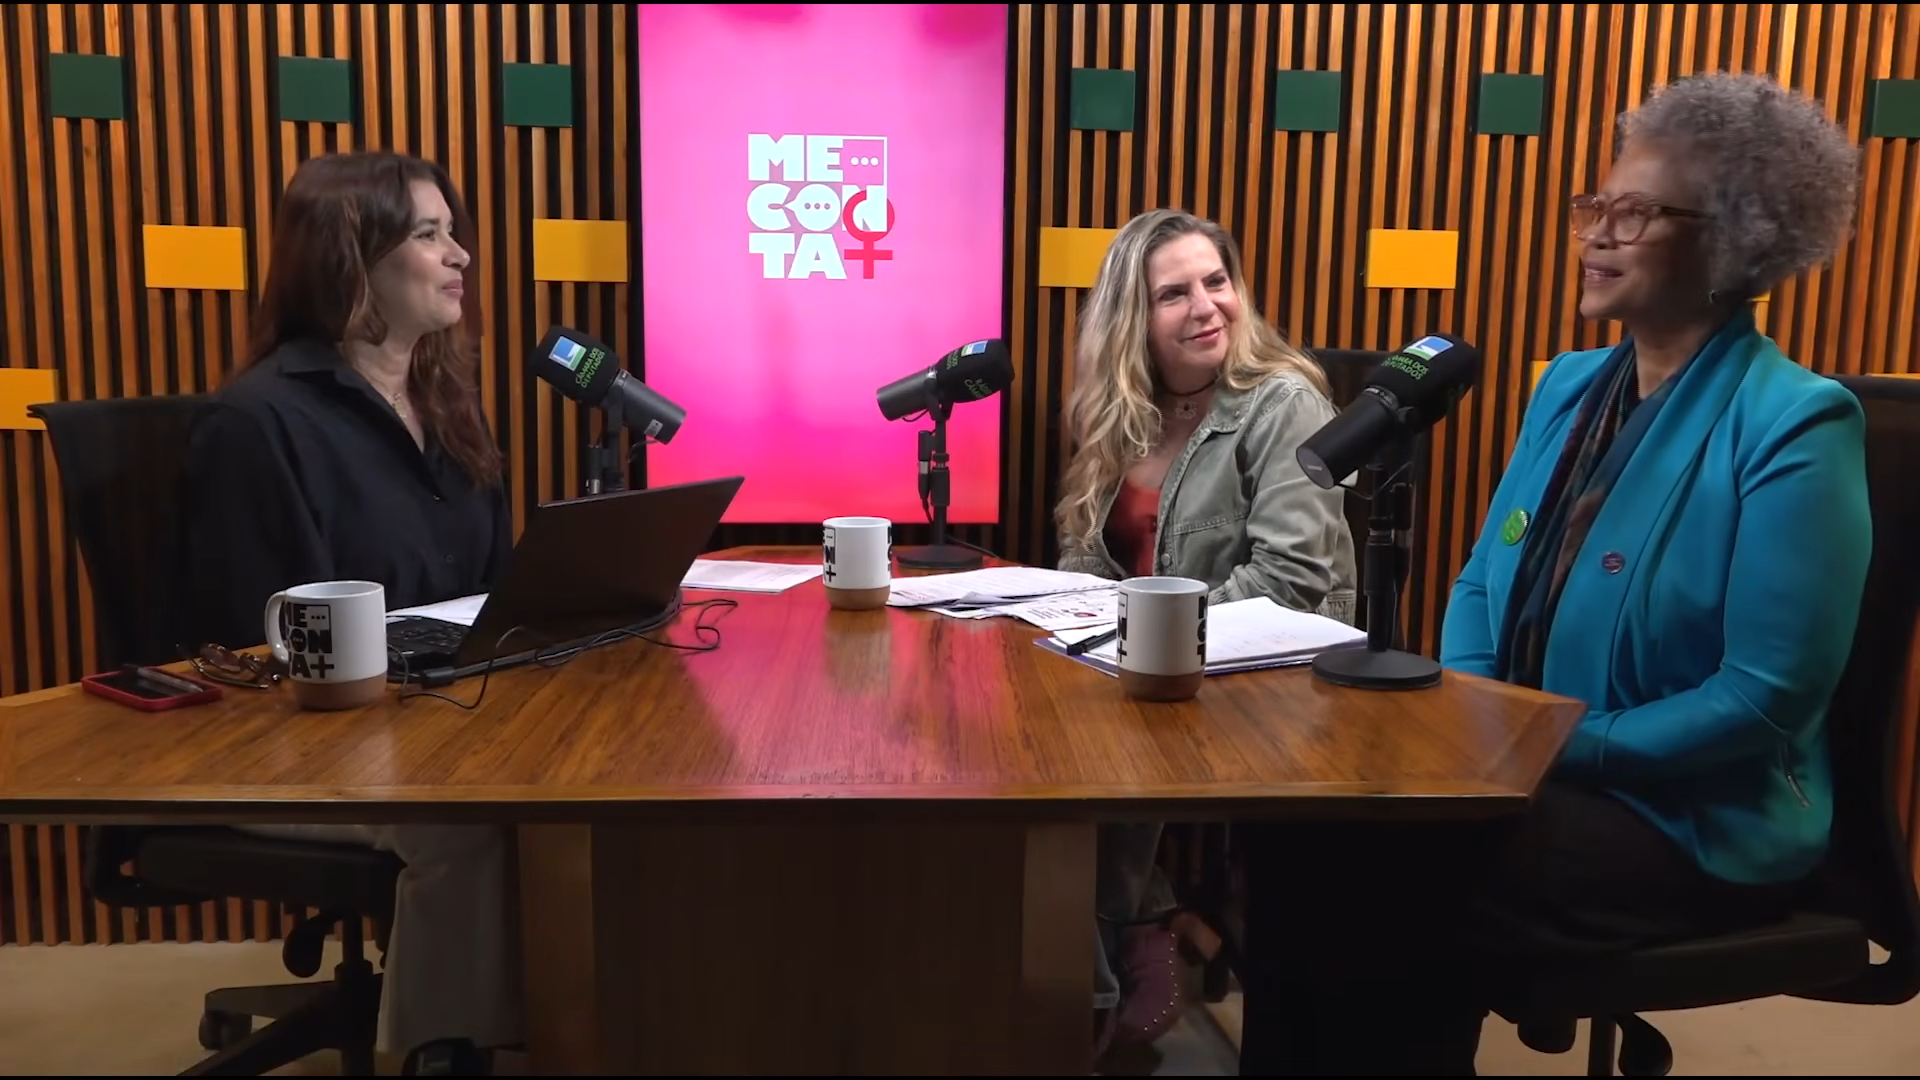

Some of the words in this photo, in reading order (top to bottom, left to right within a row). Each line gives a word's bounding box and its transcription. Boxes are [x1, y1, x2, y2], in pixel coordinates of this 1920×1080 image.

[747, 133, 844, 183] ME
[746, 183, 888, 232] CON
[1412, 360, 1430, 375] DOS
